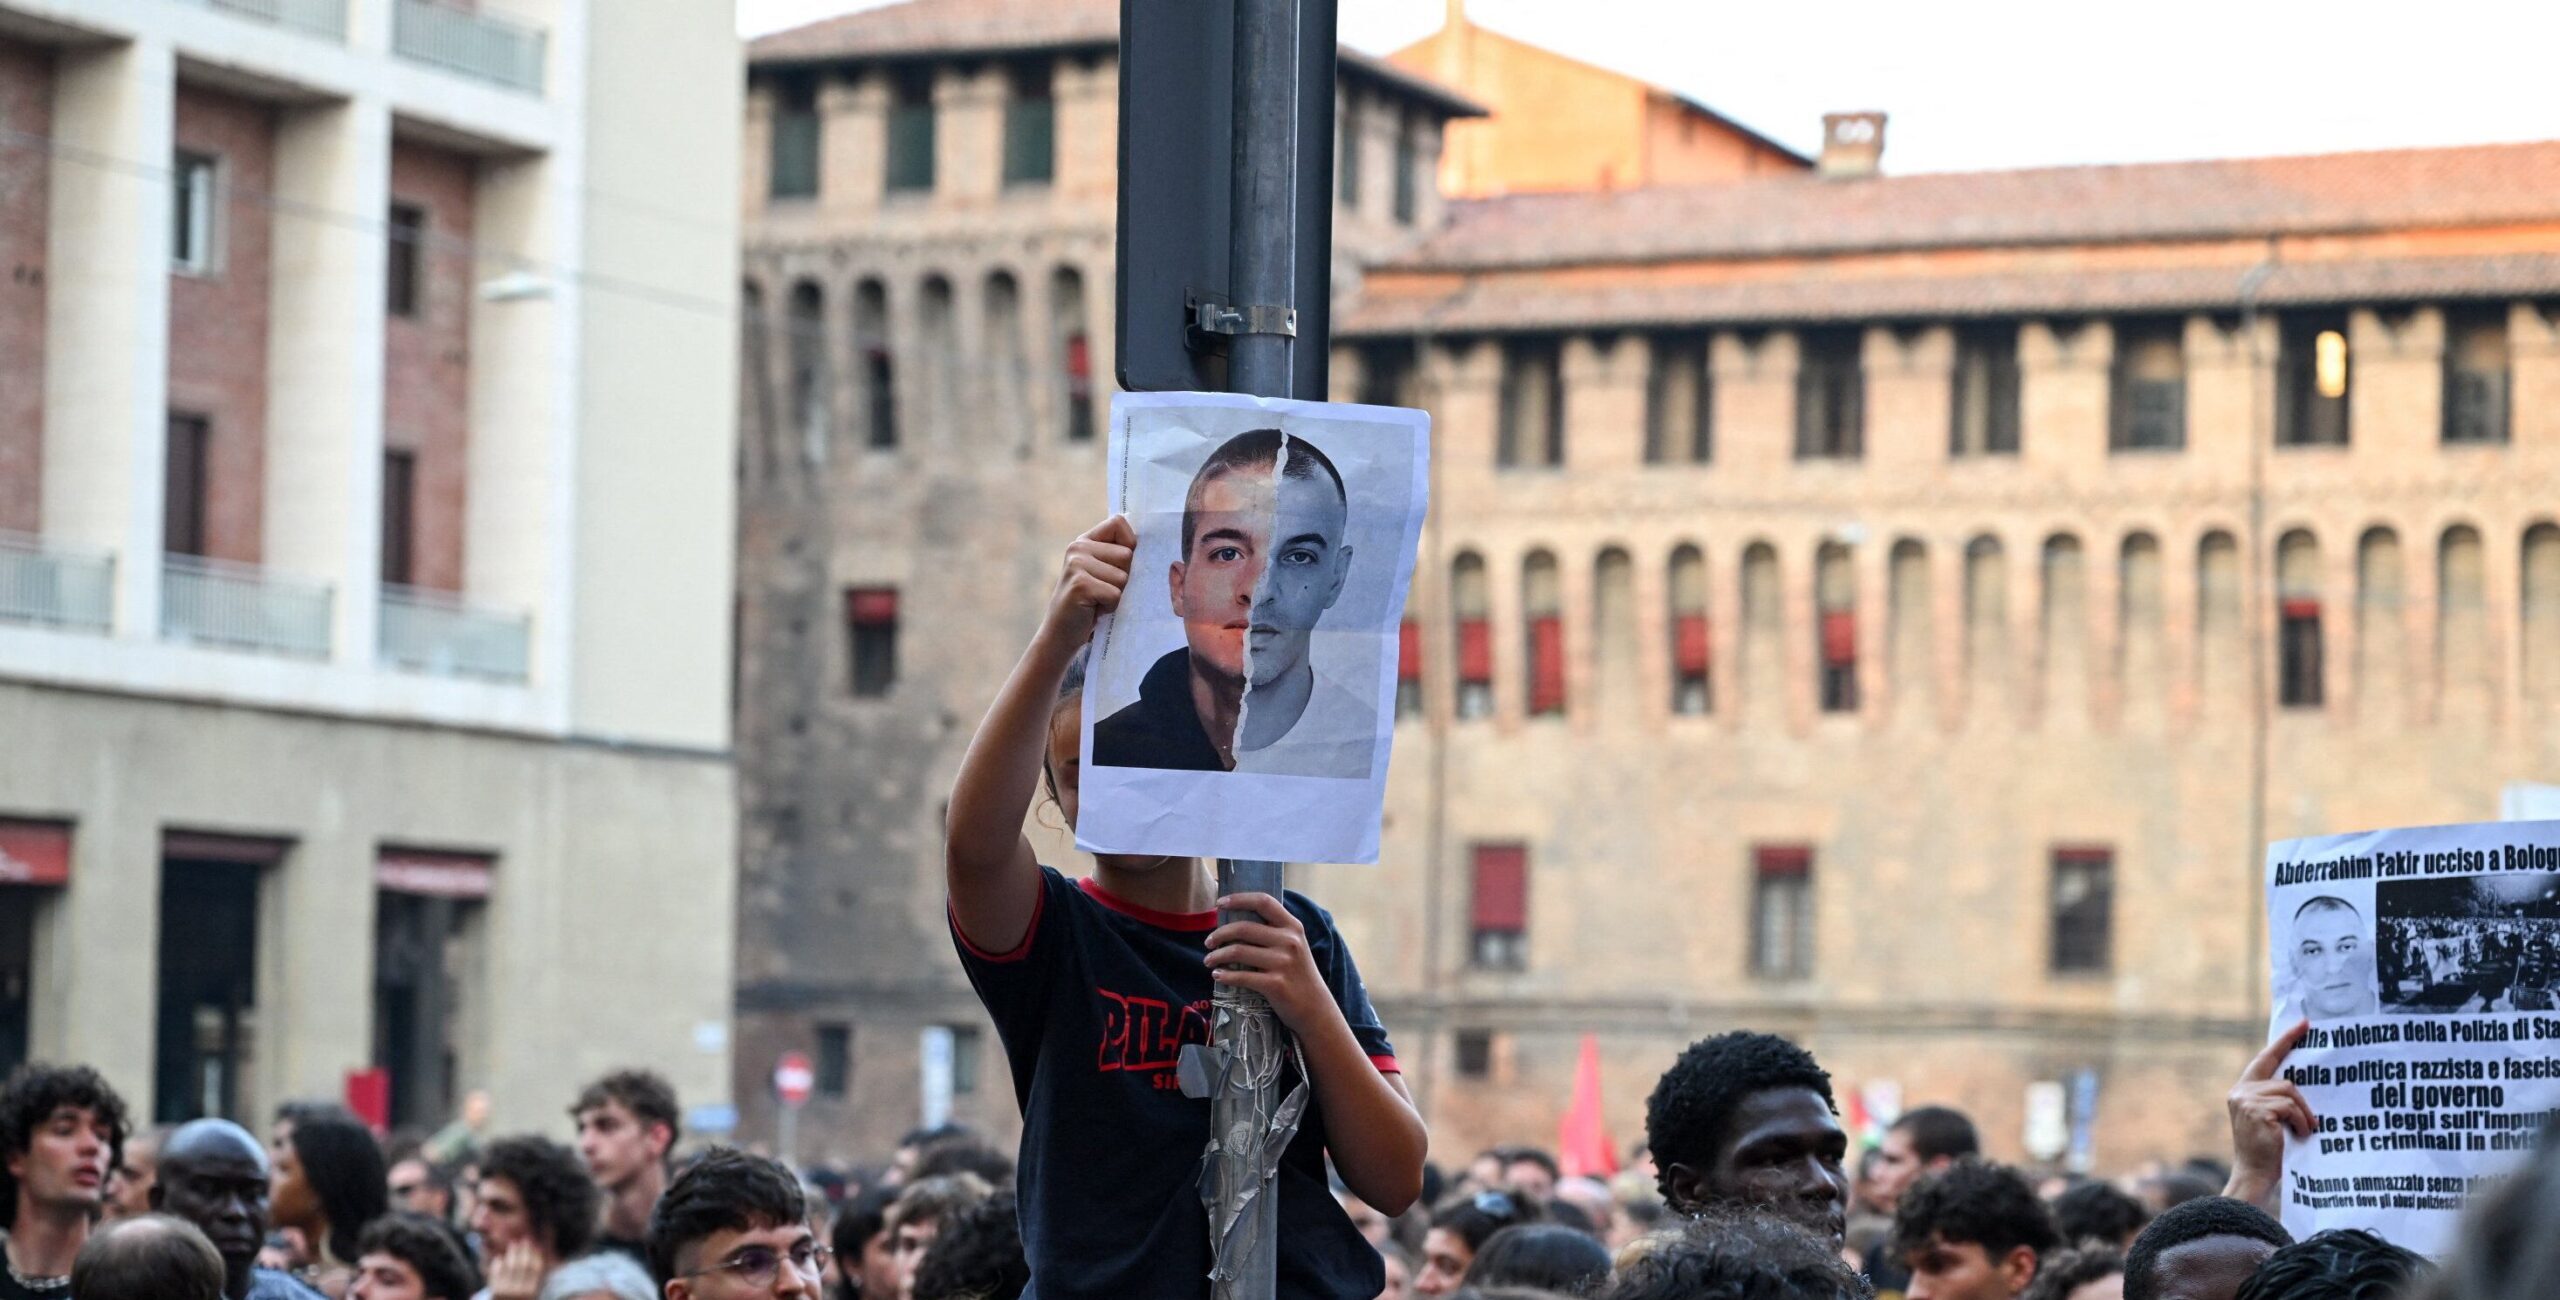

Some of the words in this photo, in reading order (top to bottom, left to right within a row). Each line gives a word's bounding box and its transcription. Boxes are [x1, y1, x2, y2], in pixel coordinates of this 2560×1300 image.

[2275, 855, 2372, 886] Abderrahim
[2376, 851, 2420, 876] Fakir
[2424, 848, 2484, 873] ucciso
[2488, 849, 2500, 871] a
[2504, 844, 2560, 871] Bolog
[2290, 1028, 2328, 1049] alla
[2331, 1021, 2400, 1048] violenza
[2403, 1020, 2446, 1042] della
[2450, 1019, 2508, 1041] Polizia
[2512, 1018, 2529, 1040] di
[2533, 1017, 2560, 1039] Sta
[2283, 1065, 2330, 1086] dalla
[2335, 1061, 2407, 1086] politica
[2411, 1057, 2484, 1080] razzista
[2488, 1061, 2500, 1079] e
[2504, 1057, 2560, 1079] fascis
[2371, 1082, 2406, 1108] del
[2412, 1085, 2504, 1110] governo
[2342, 1114, 2380, 1132] sue
[2384, 1110, 2436, 1131] leggi
[2320, 1137, 2354, 1155] per
[2359, 1134, 2366, 1151] i
[2370, 1131, 2461, 1151] criminali
[2466, 1131, 2486, 1151] in
[2490, 1130, 2538, 1151] divis
[2307, 1175, 2350, 1193] hanno
[2353, 1174, 2424, 1192] ammazzato
[2427, 1176, 2464, 1193] senza
[2311, 1193, 2355, 1210] quartiere
[2356, 1193, 2378, 1207] dove
[2379, 1193, 2391, 1209] gli
[2393, 1194, 2415, 1208] abusi
